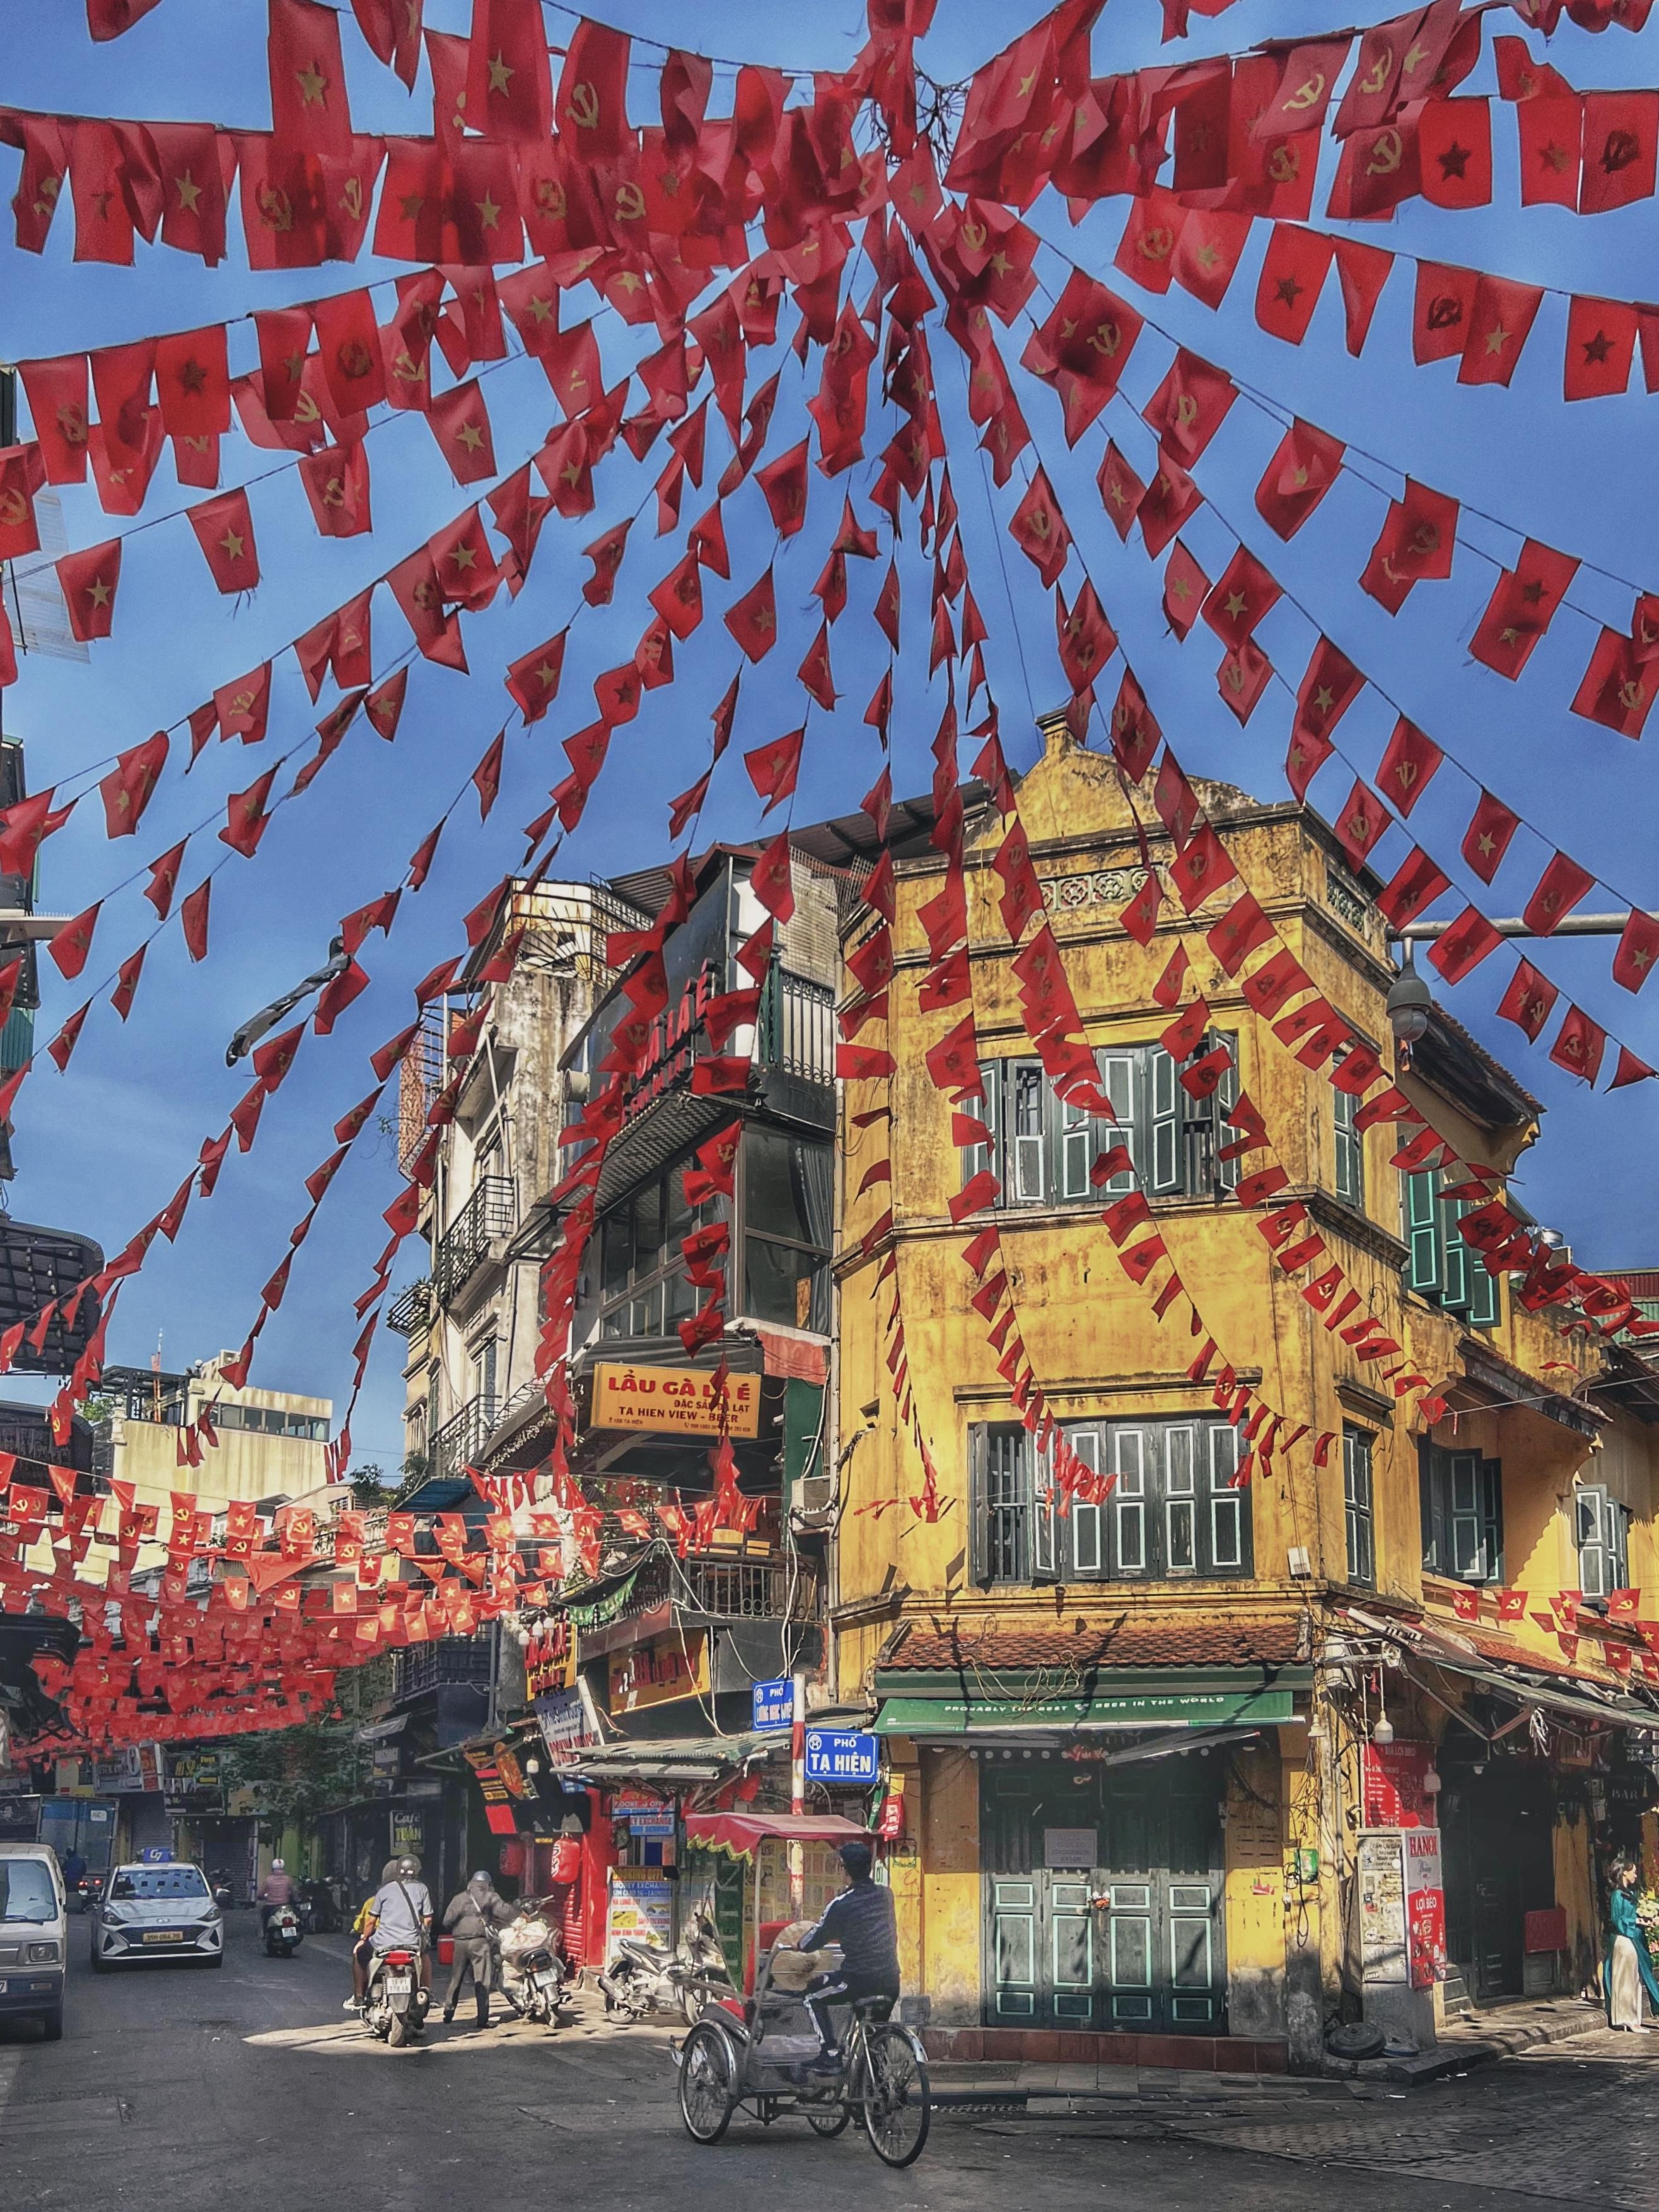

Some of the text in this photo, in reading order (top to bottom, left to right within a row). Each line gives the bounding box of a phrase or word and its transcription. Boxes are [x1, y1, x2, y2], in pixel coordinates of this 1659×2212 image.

[608, 1370, 656, 1393] LẨU
[663, 1378, 696, 1397] GÀ
[737, 1383, 750, 1400] É
[619, 1406, 634, 1416] TA
[637, 1409, 665, 1418] HIEN
[668, 1411, 697, 1420] VIEW
[709, 1412, 738, 1423] BEER
[674, 1399, 693, 1409] ĐẶC
[733, 1405, 750, 1414] LẠT
[770, 1684, 783, 1697] PHỐ
[834, 1735, 858, 1748] PHỐ
[811, 1751, 871, 1775] TẠ HIỆN
[1416, 1897, 1437, 1913] LỢI BÉO
